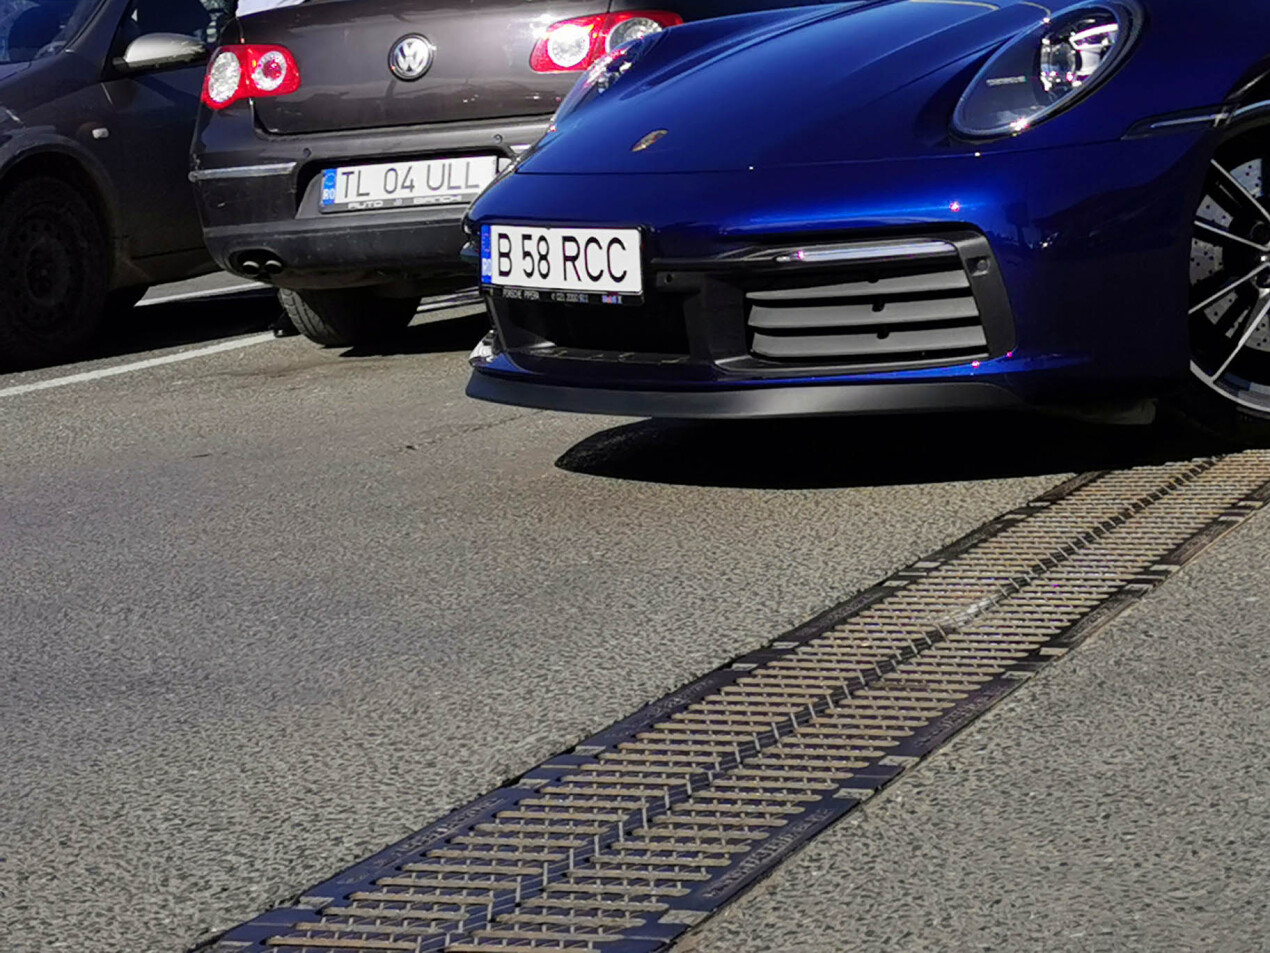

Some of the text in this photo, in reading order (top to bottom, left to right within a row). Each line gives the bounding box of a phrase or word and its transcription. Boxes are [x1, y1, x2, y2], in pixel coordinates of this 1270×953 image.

[341, 162, 480, 198] TL 04 ULL
[497, 233, 628, 283] B 58 RCC
